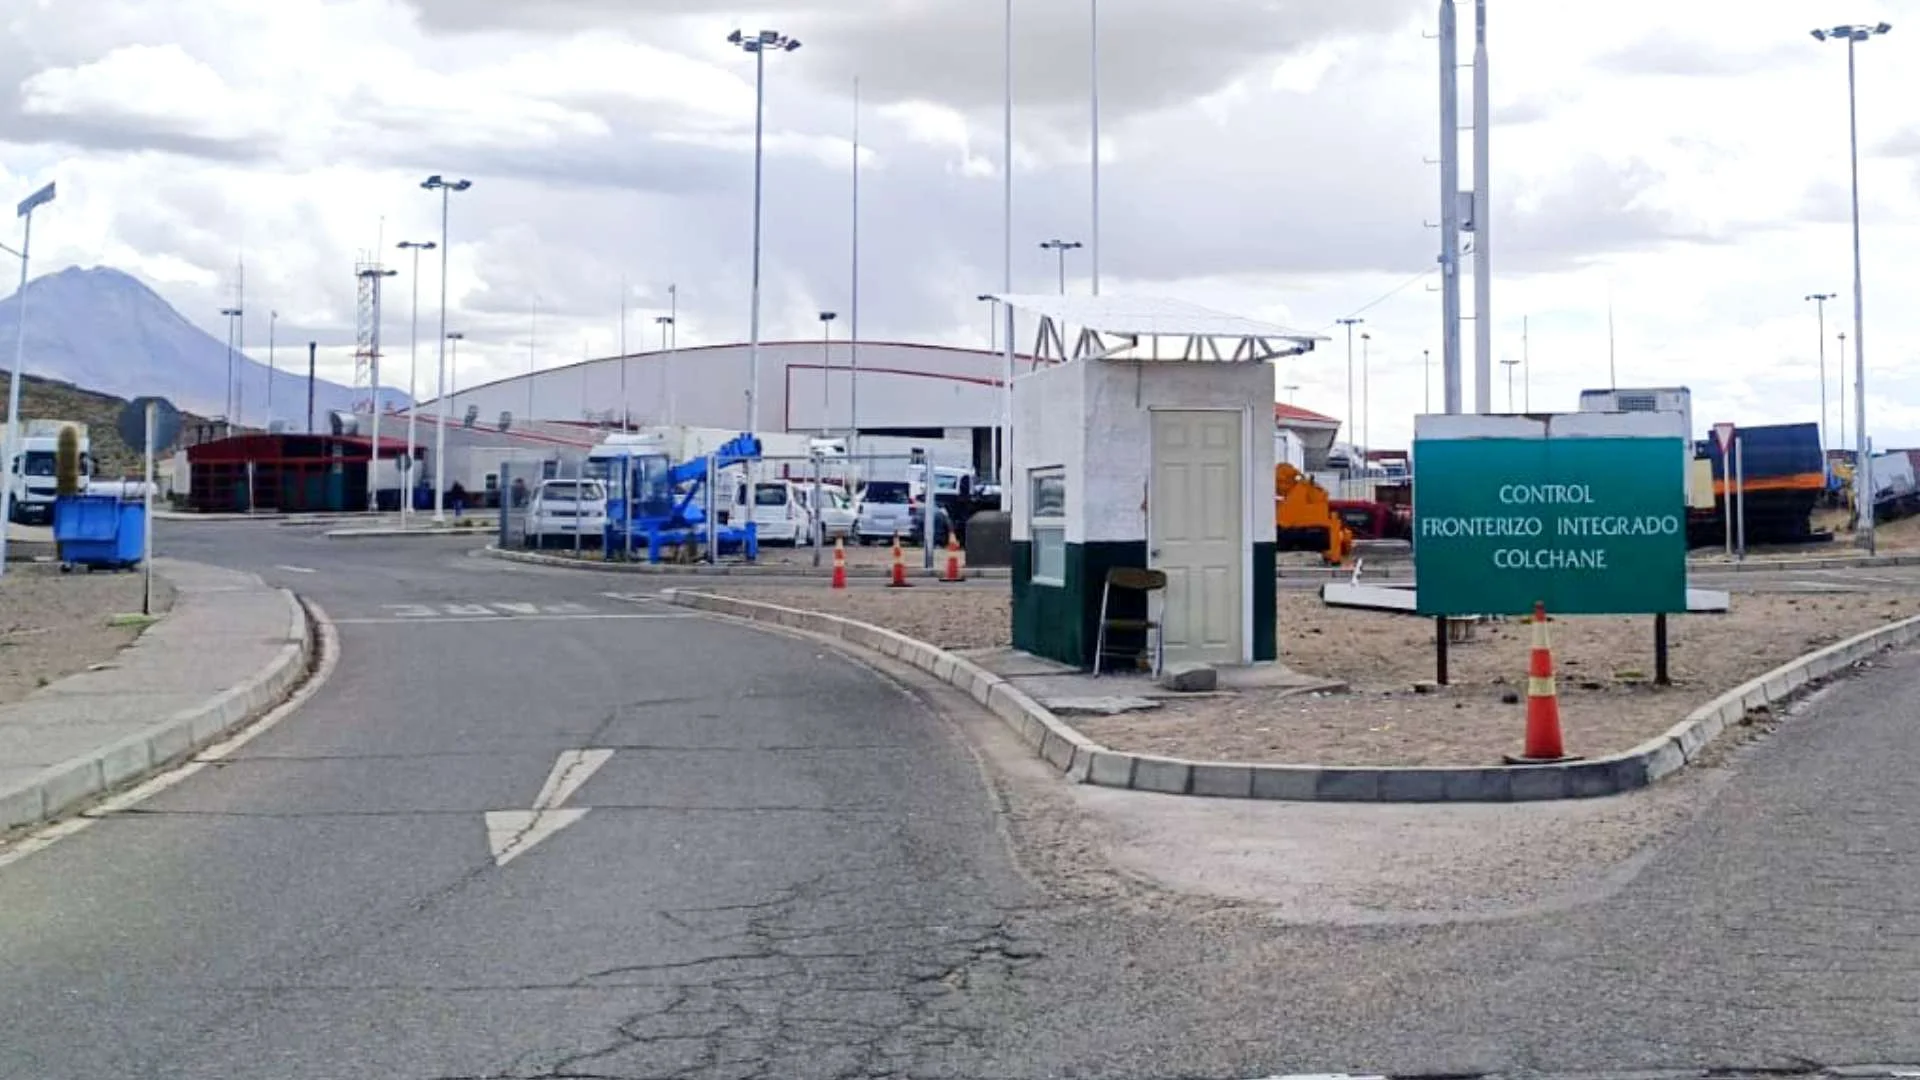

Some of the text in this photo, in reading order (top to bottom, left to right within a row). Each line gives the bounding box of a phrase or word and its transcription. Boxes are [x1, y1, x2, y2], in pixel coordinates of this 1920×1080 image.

[1499, 484, 1594, 504] CONTROL
[1422, 515, 1678, 537] FRONTERIZO INTEGRADO
[1493, 549, 1607, 568] COLCHANE
